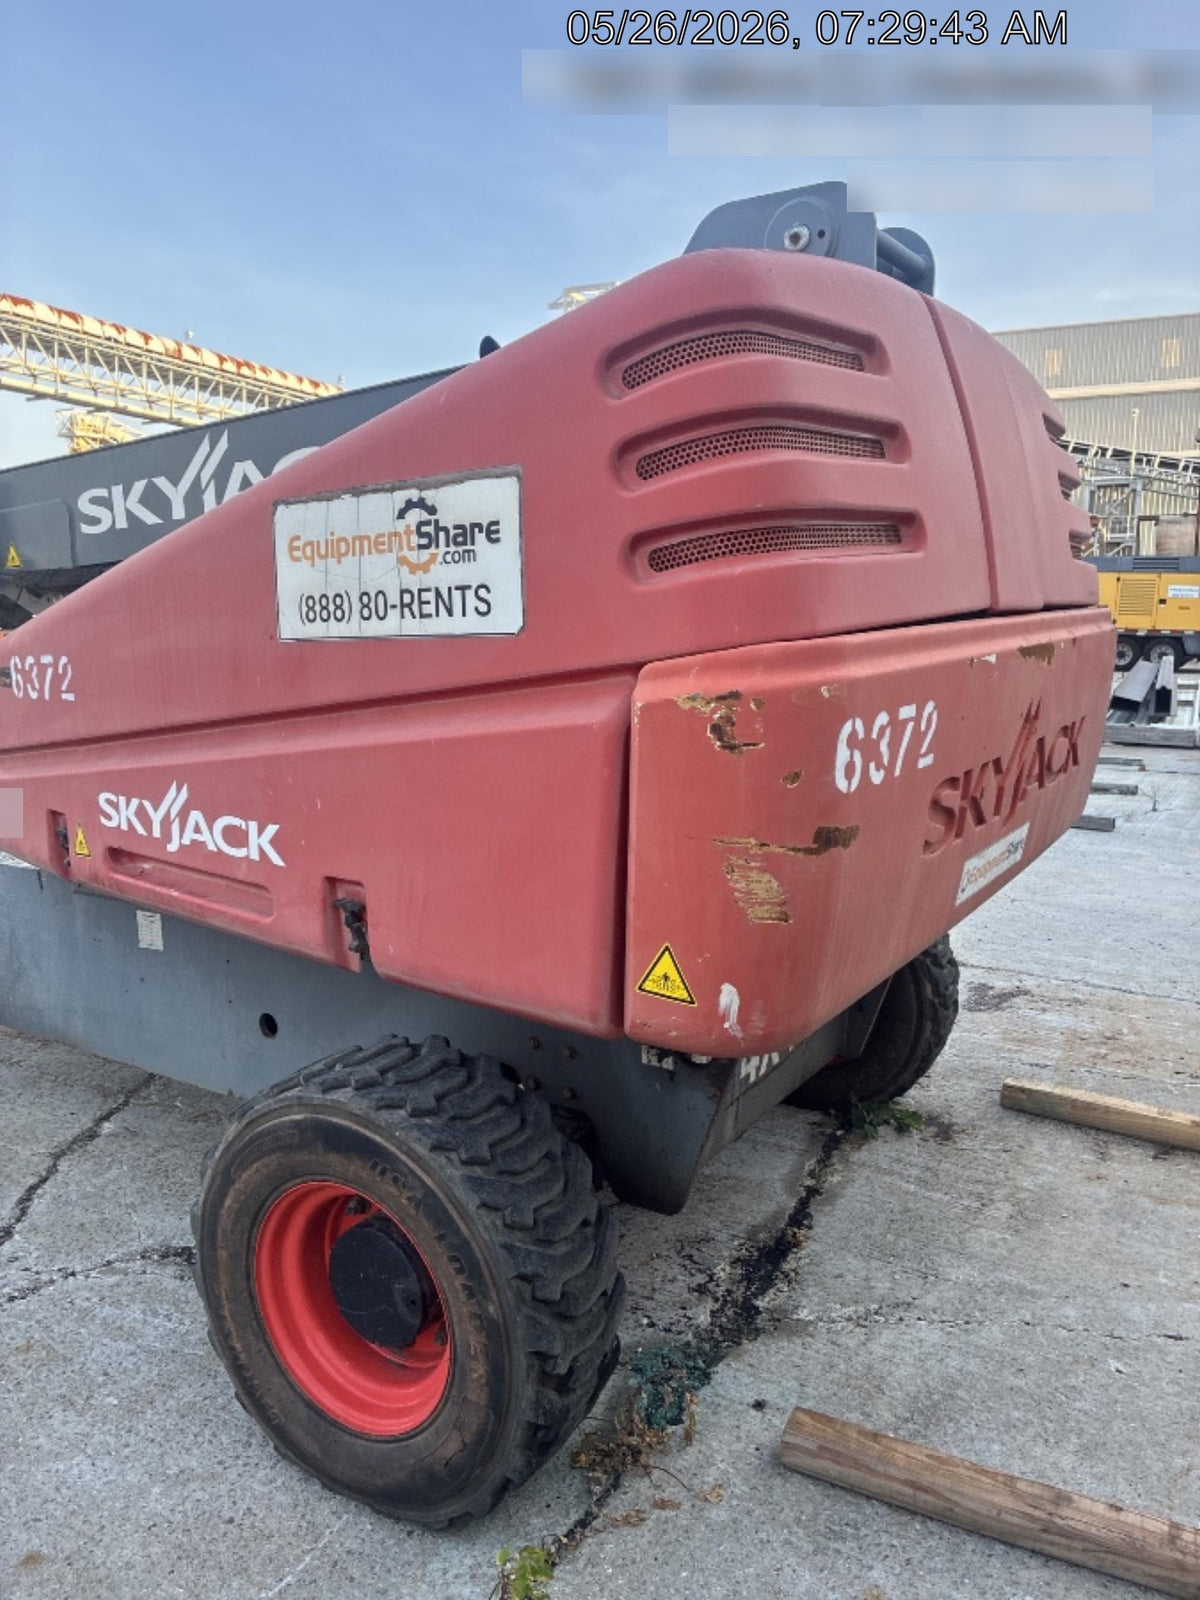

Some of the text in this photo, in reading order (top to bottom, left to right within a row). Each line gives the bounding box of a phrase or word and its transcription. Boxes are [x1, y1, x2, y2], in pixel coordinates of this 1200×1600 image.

[287, 518, 502, 568] EquipmentShare
[439, 548, 477, 565] .com
[299, 583, 492, 626] (888) 80-RENTS
[10, 655, 75, 701] 6372
[835, 700, 938, 794] 6372
[921, 697, 1086, 858] SKYJACK
[98, 780, 286, 867] SKYJACK
